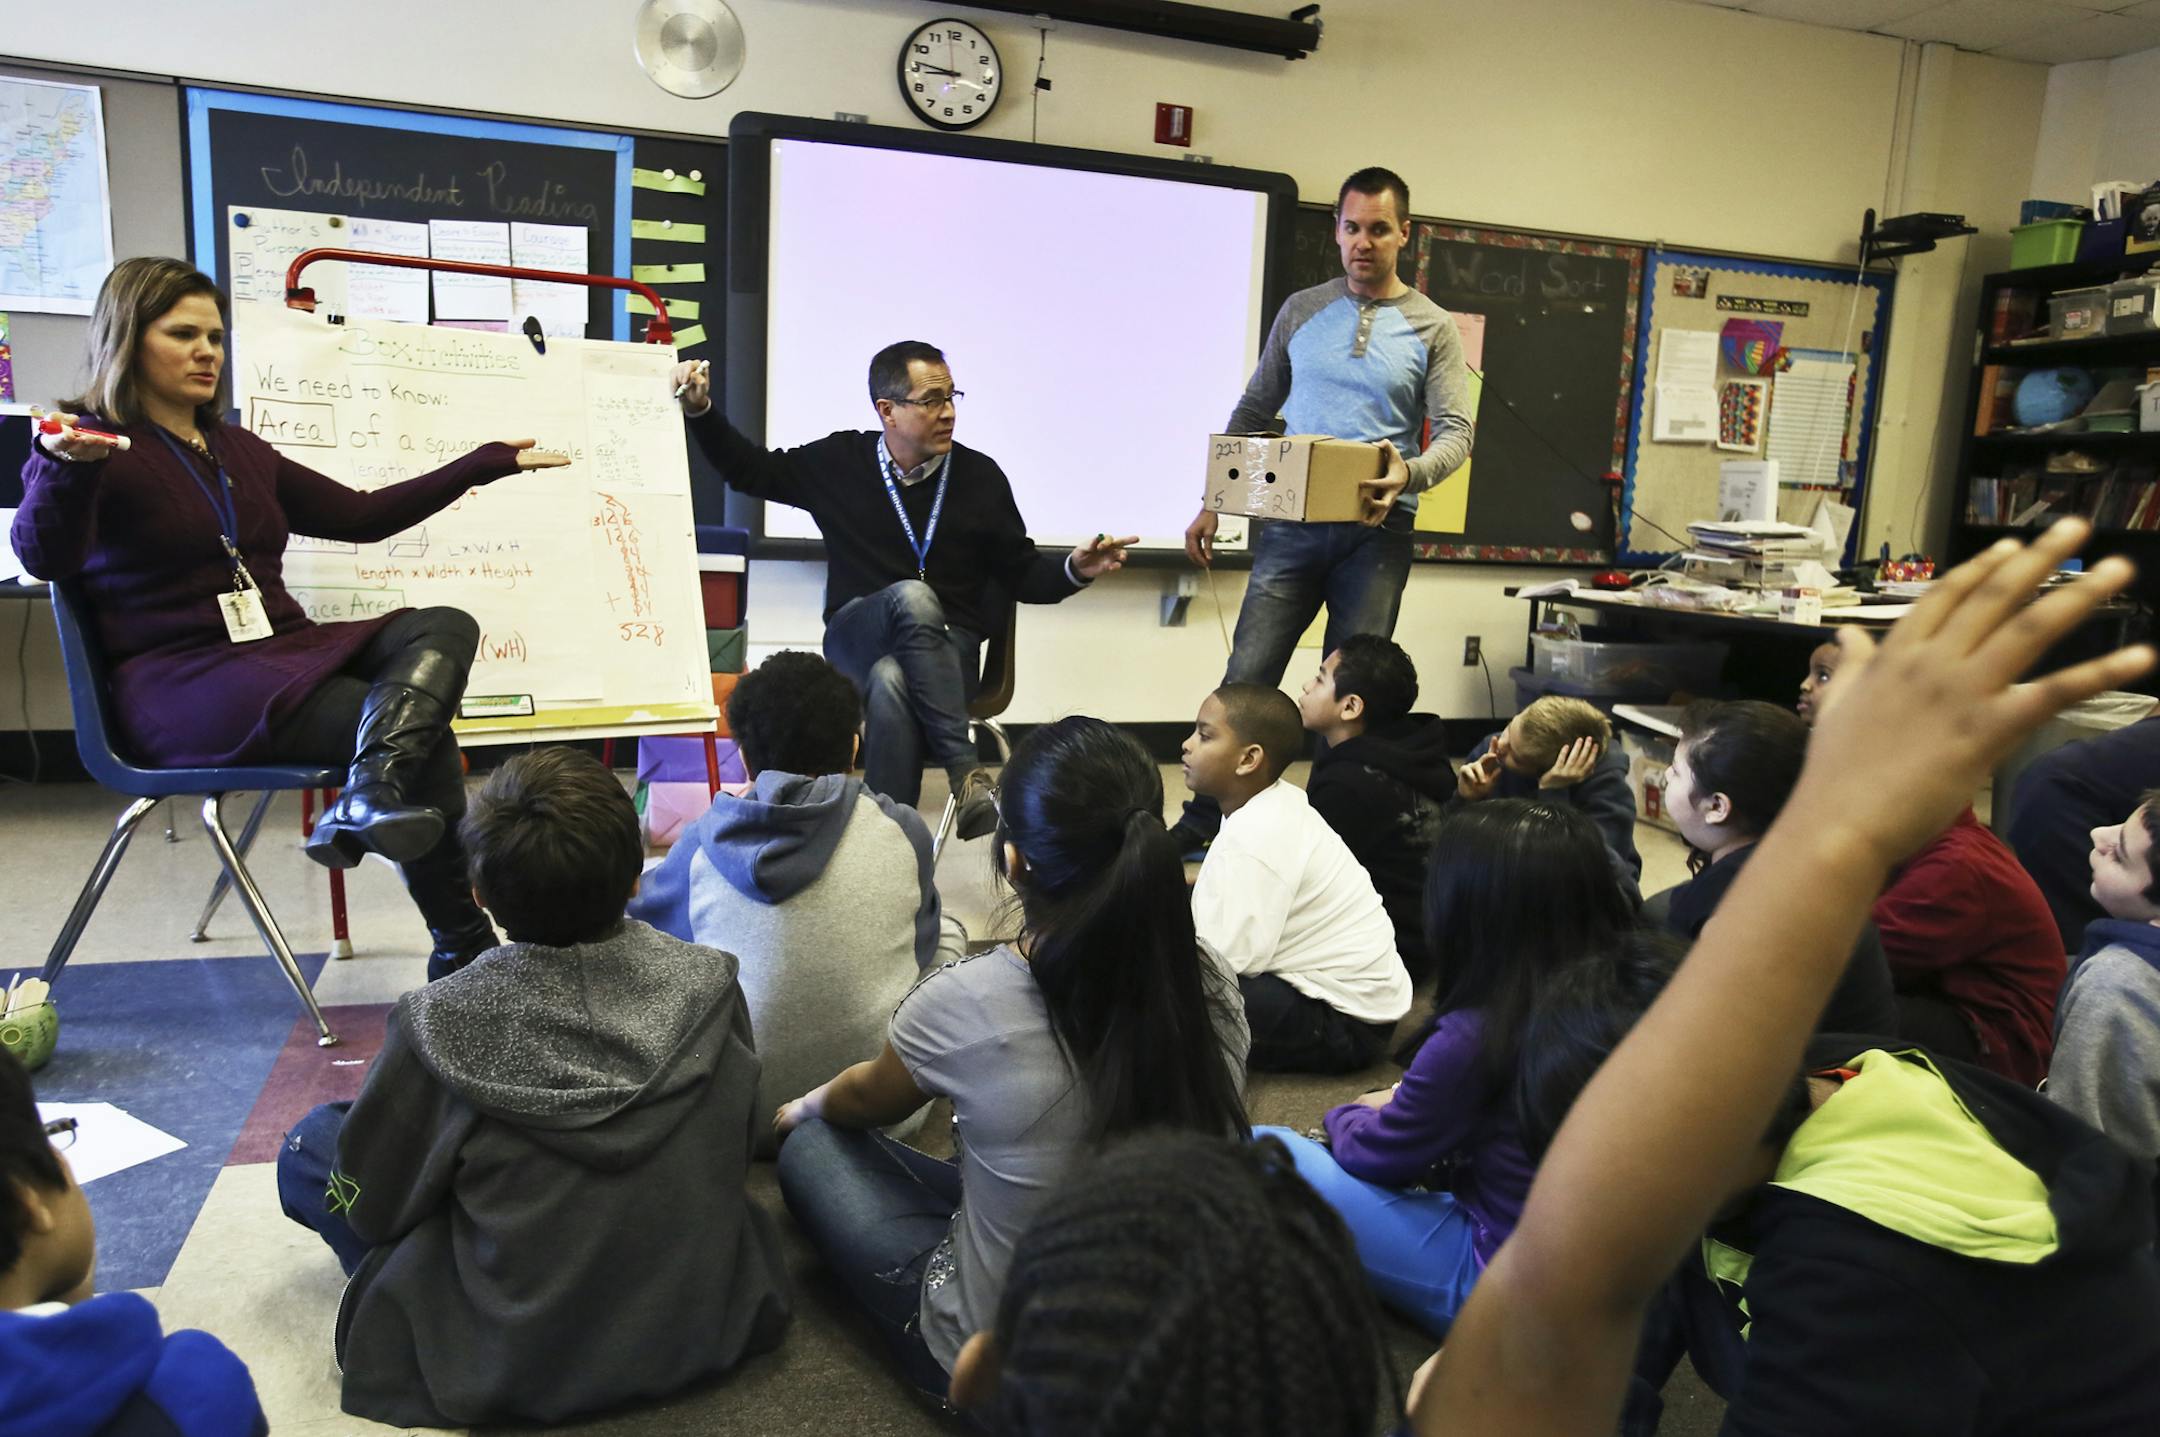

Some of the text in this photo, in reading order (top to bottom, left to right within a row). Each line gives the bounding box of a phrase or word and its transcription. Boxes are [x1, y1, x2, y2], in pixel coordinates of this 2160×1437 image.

[929, 32, 942, 43] 11
[947, 30, 962, 41] 12
[970, 40, 977, 49] 1
[913, 43, 930, 54] 10
[979, 55, 990, 65] 2
[914, 83, 925, 93] 8
[976, 93, 986, 102] 4
[926, 98, 936, 108] 7
[944, 107, 953, 117] 6
[962, 105, 973, 114] 5
[261, 145, 600, 226] Independent Reading
[1441, 249, 1606, 298] Word Sort
[338, 327, 412, 361] Box
[254, 362, 289, 393] We
[298, 374, 353, 400] need
[361, 382, 381, 400] to
[259, 409, 322, 441] Area
[350, 412, 380, 448] of
[400, 434, 415, 451] a
[425, 437, 485, 463] squar
[1215, 441, 1242, 460] 221
[1279, 440, 1292, 463] P
[351, 457, 409, 486] length
[1213, 490, 1225, 509] 5
[1271, 488, 1296, 514] 29
[889, 489, 915, 543] MINNESOTA
[473, 541, 490, 553] W
[355, 564, 404, 589] length
[482, 562, 533, 590] Height
[350, 592, 400, 617] Area
[619, 623, 664, 647] 528
